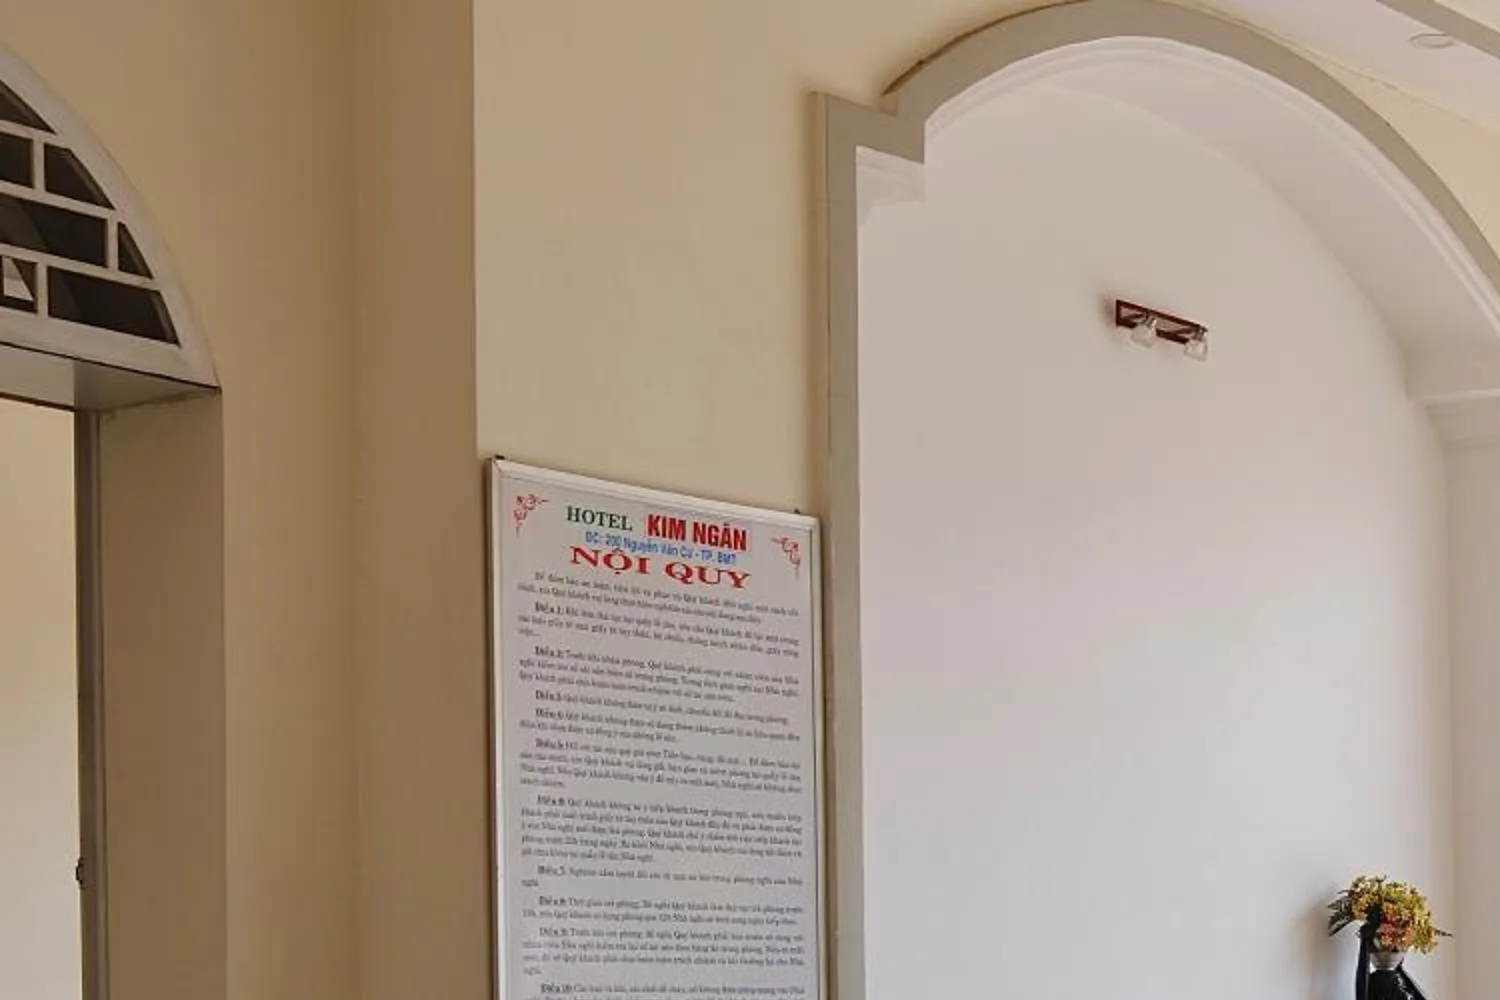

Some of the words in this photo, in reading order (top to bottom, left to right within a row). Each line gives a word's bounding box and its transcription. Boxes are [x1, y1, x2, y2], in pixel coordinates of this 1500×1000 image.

[566, 505, 633, 531] HOTEL
[647, 513, 687, 542] KIM
[693, 521, 747, 551] NGÂN
[569, 545, 651, 575] NỘI
[664, 561, 752, 590] QUY
